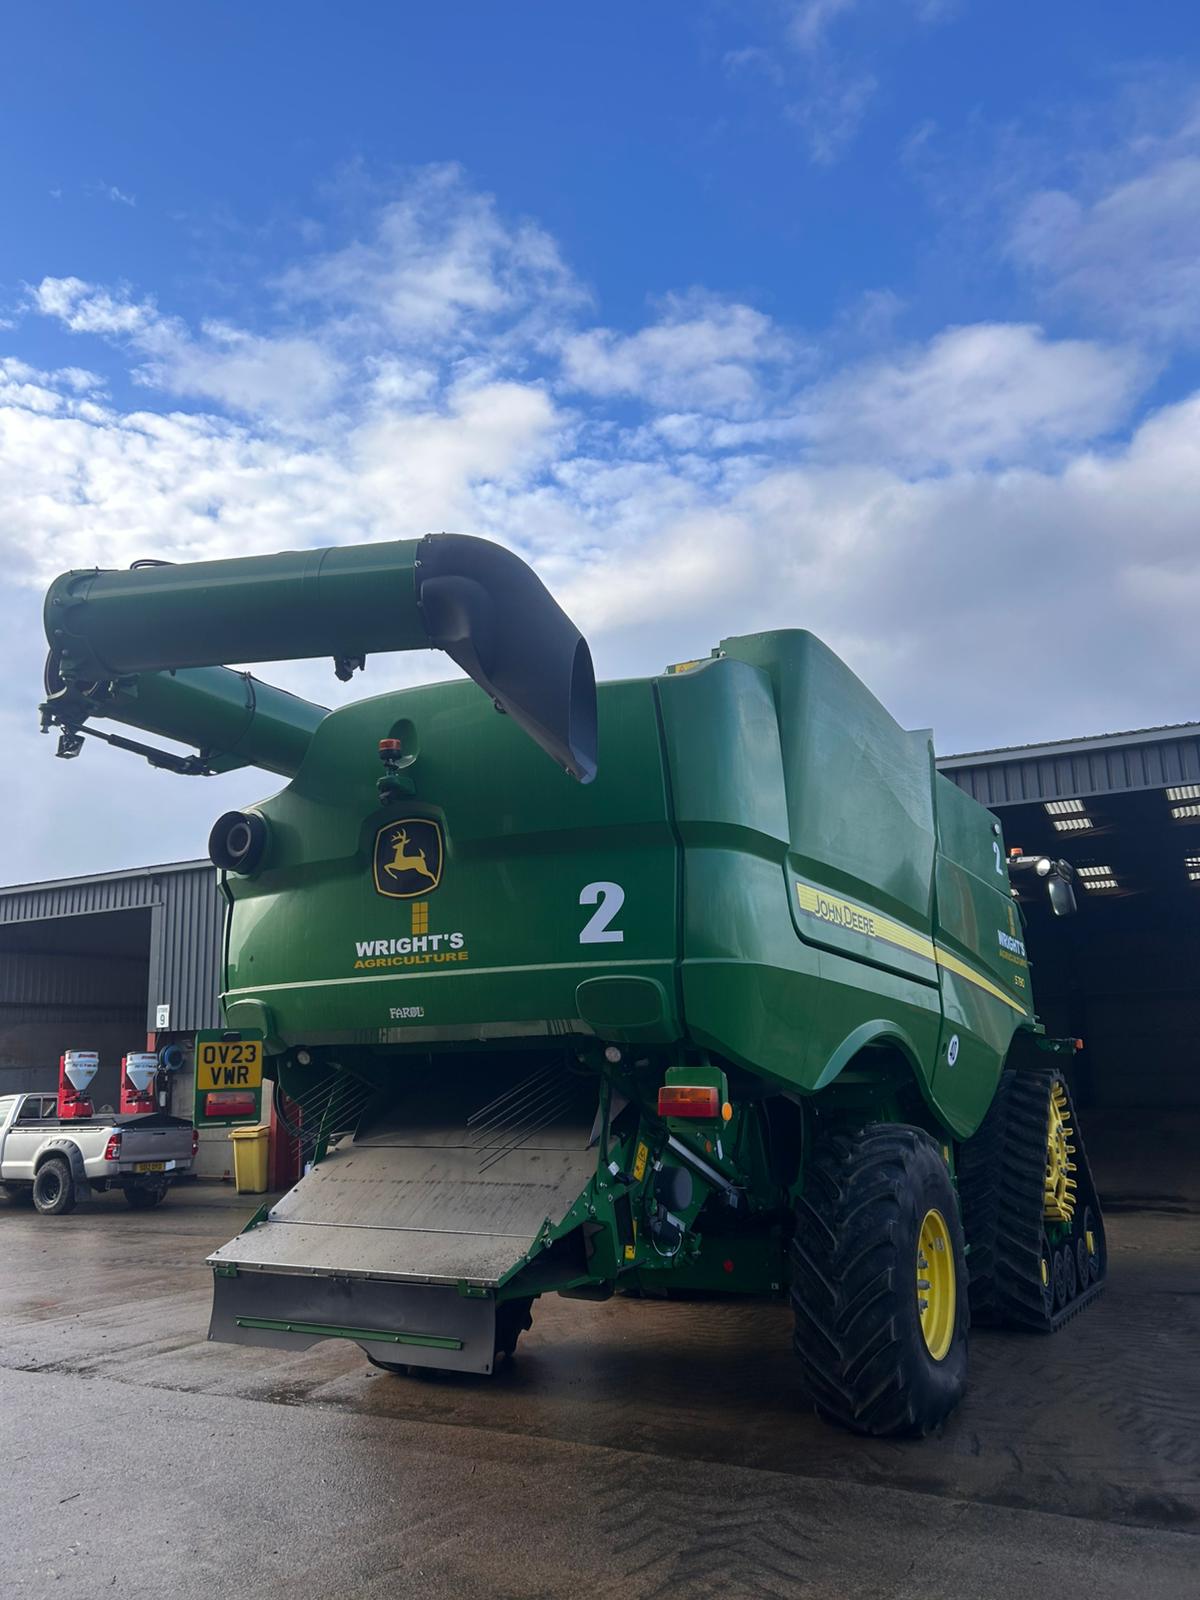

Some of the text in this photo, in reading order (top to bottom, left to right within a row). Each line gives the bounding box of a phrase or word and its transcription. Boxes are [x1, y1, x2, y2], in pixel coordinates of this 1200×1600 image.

[992, 841, 1004, 876] 2
[578, 881, 626, 944] 2
[814, 894, 876, 935] JOHN DEERE
[355, 932, 465, 958] WRIGHT'S
[353, 951, 469, 969] AGRICULTURE
[159, 1014, 166, 1026] 9
[389, 1006, 425, 1019] FAROL
[203, 1044, 256, 1064] OV23
[210, 1065, 249, 1086] VWR
